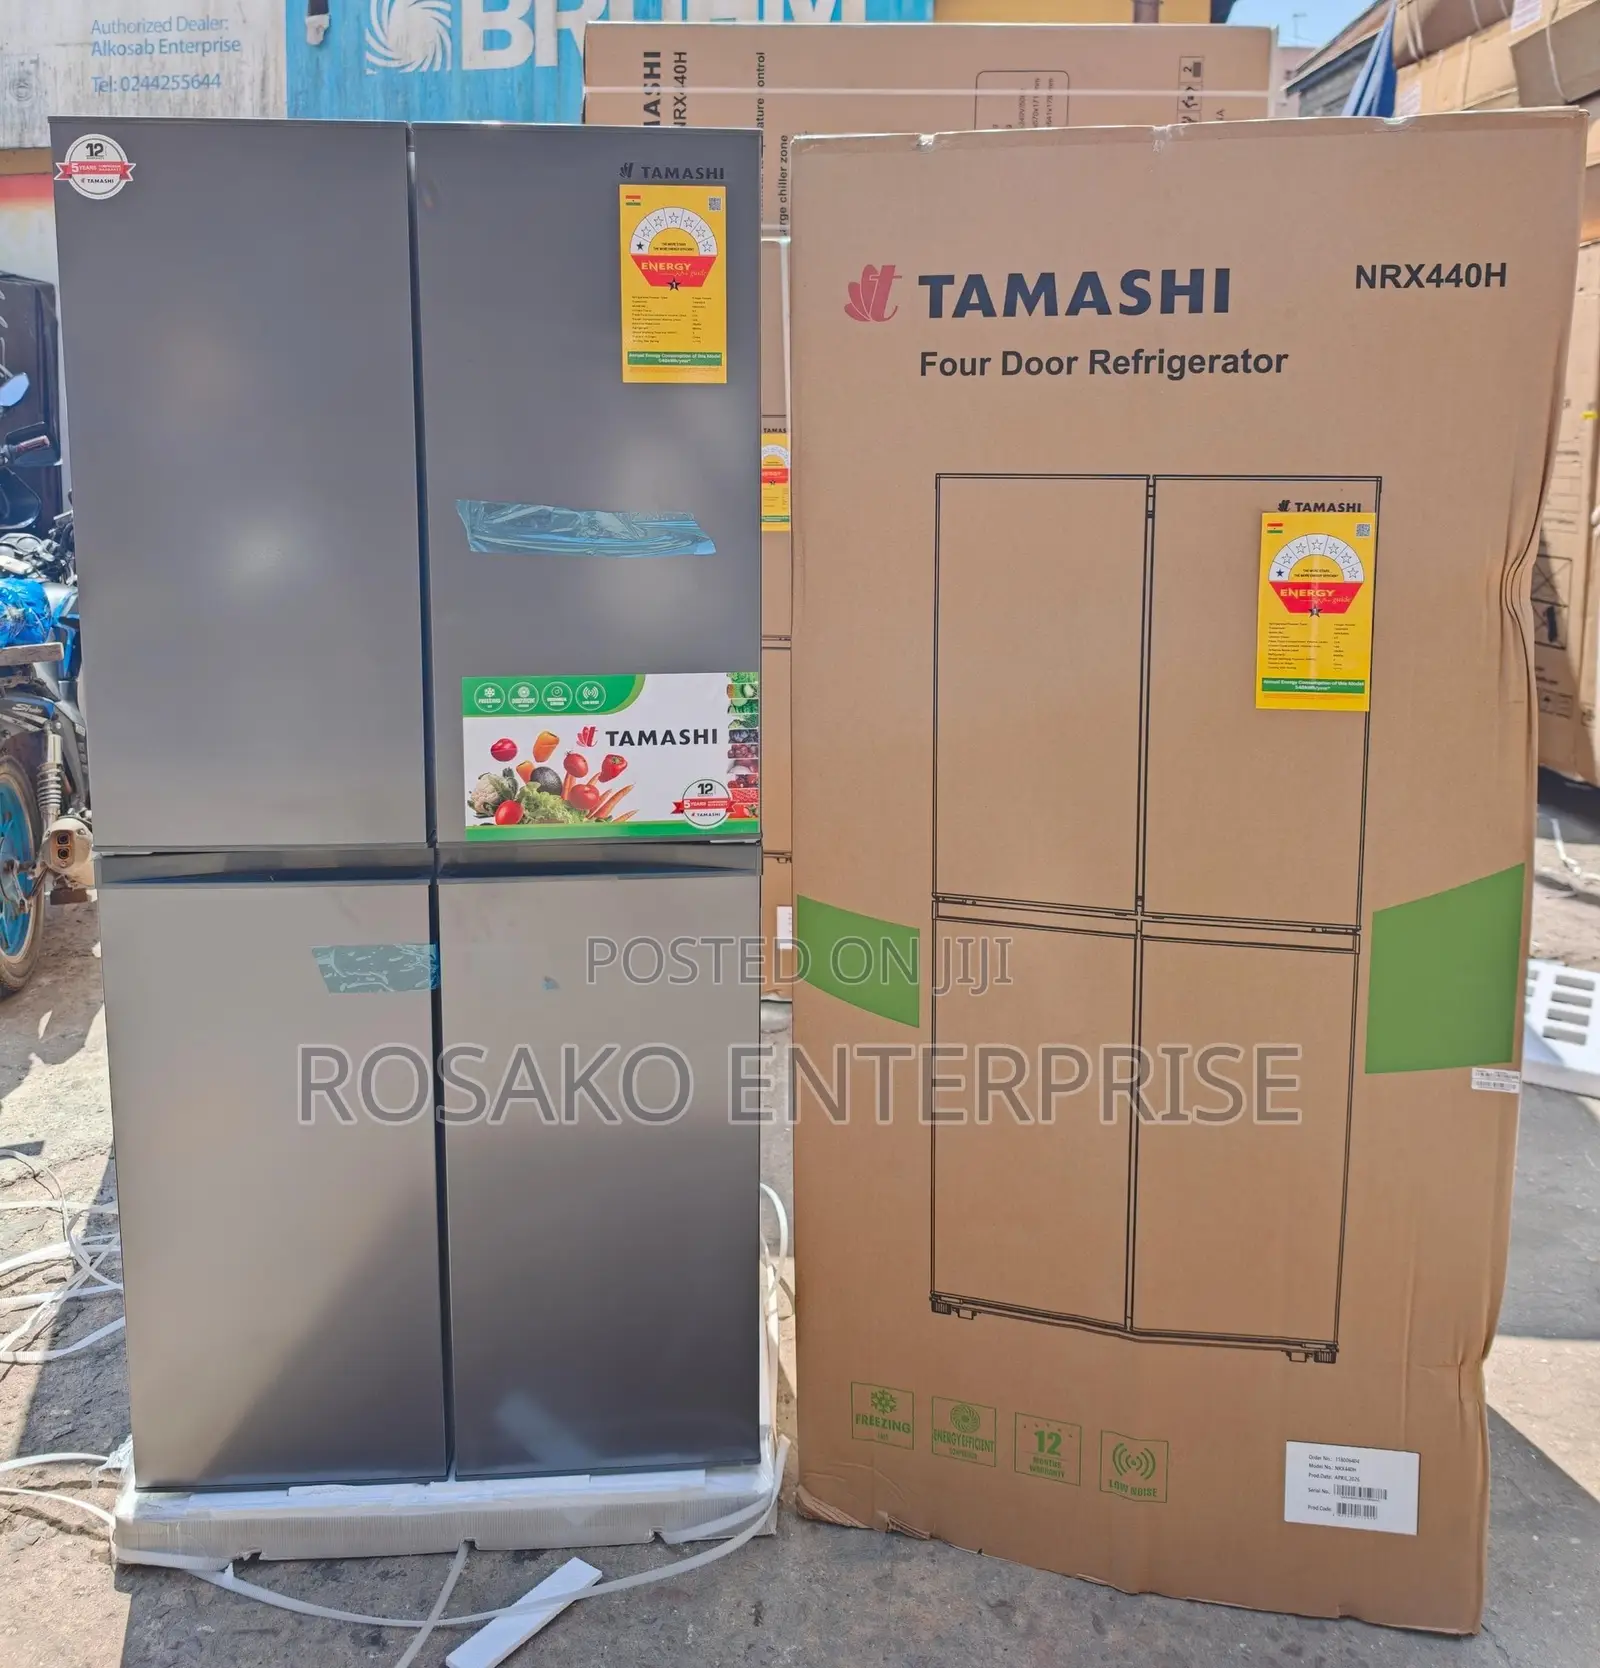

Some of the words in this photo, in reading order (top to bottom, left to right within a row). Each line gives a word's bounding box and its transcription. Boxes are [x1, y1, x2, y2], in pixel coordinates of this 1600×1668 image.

[90, 16, 172, 36] Authorized
[176, 15, 229, 33] Dealer:
[90, 39, 155, 57] Alkosab
[159, 37, 242, 57] Enterprise
[91, 76, 118, 93] Tel:
[120, 74, 222, 92] 0244255644
[756, 52, 765, 97] ontrol
[643, 51, 661, 126] ASHI
[673, 51, 688, 127] RX40H
[85, 142, 104, 157] 12
[779, 135, 789, 164] zone
[71, 162, 80, 173] 5
[641, 166, 725, 180] TAMASHI
[777, 166, 788, 204] chiller
[641, 261, 691, 272] ENERGY
[918, 267, 1231, 319] TAMASHI
[1355, 262, 1508, 289] NRX440H
[920, 350, 991, 377] Four
[1001, 349, 1079, 376] Door
[1089, 346, 1289, 381] Refrigerator
[1295, 502, 1362, 513] TAMASHI
[1280, 587, 1336, 599] ENERGY
[605, 728, 718, 747] TAMASHI
[697, 783, 713, 794] 12
[684, 800, 690, 808] 5
[855, 1414, 911, 1434] FREEZING
[933, 1429, 962, 1446] ENERGY
[962, 1433, 994, 1453] EFFICIENT
[1034, 1430, 1062, 1456] 12
[1109, 1479, 1130, 1493] LOW
[1130, 1485, 1157, 1498] NOISE
